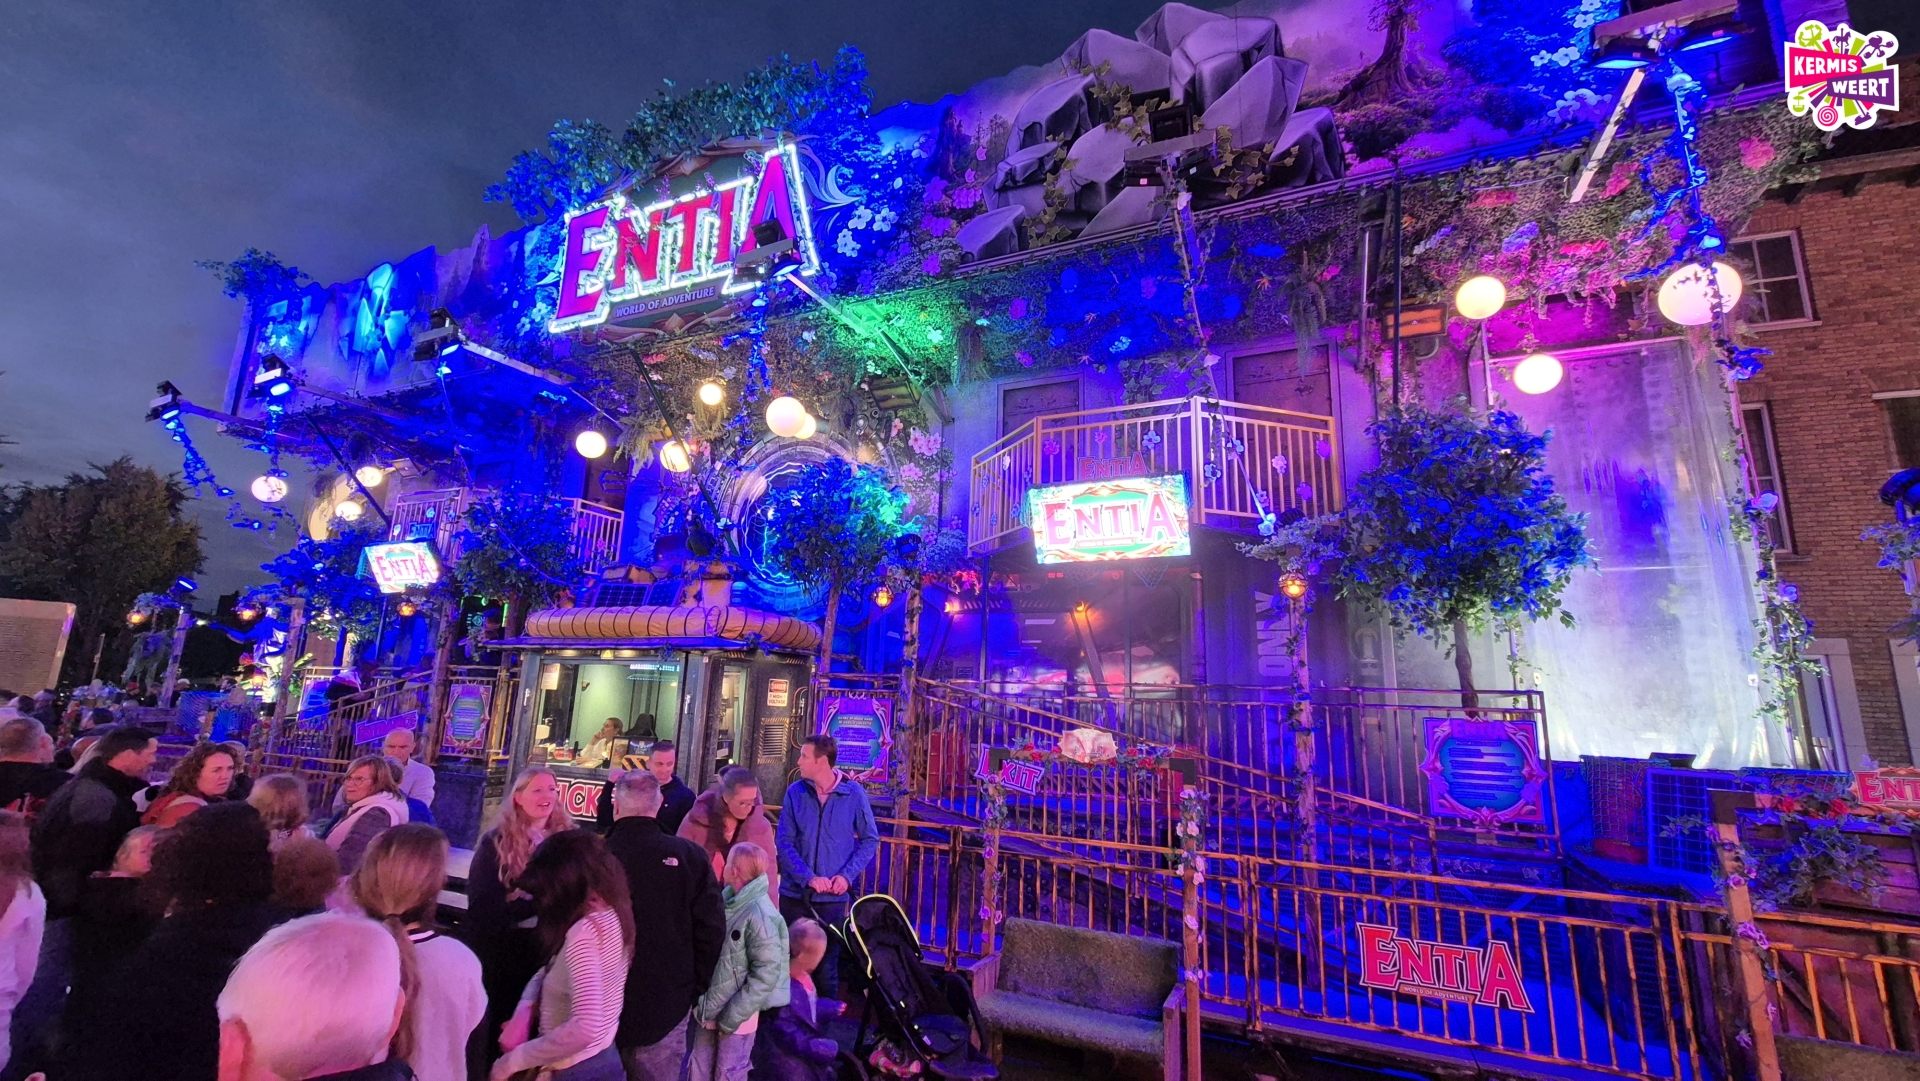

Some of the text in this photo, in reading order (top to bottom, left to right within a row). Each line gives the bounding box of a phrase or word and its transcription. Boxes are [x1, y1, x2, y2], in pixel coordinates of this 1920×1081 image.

[553, 146, 818, 329] ENTIA
[616, 286, 715, 317] WORLD OF ADVENTURE
[1079, 452, 1147, 480] ENTIA
[1043, 491, 1180, 546] ENTIA
[374, 553, 436, 582] ENTIA
[1359, 925, 1532, 1011] ENTIA
